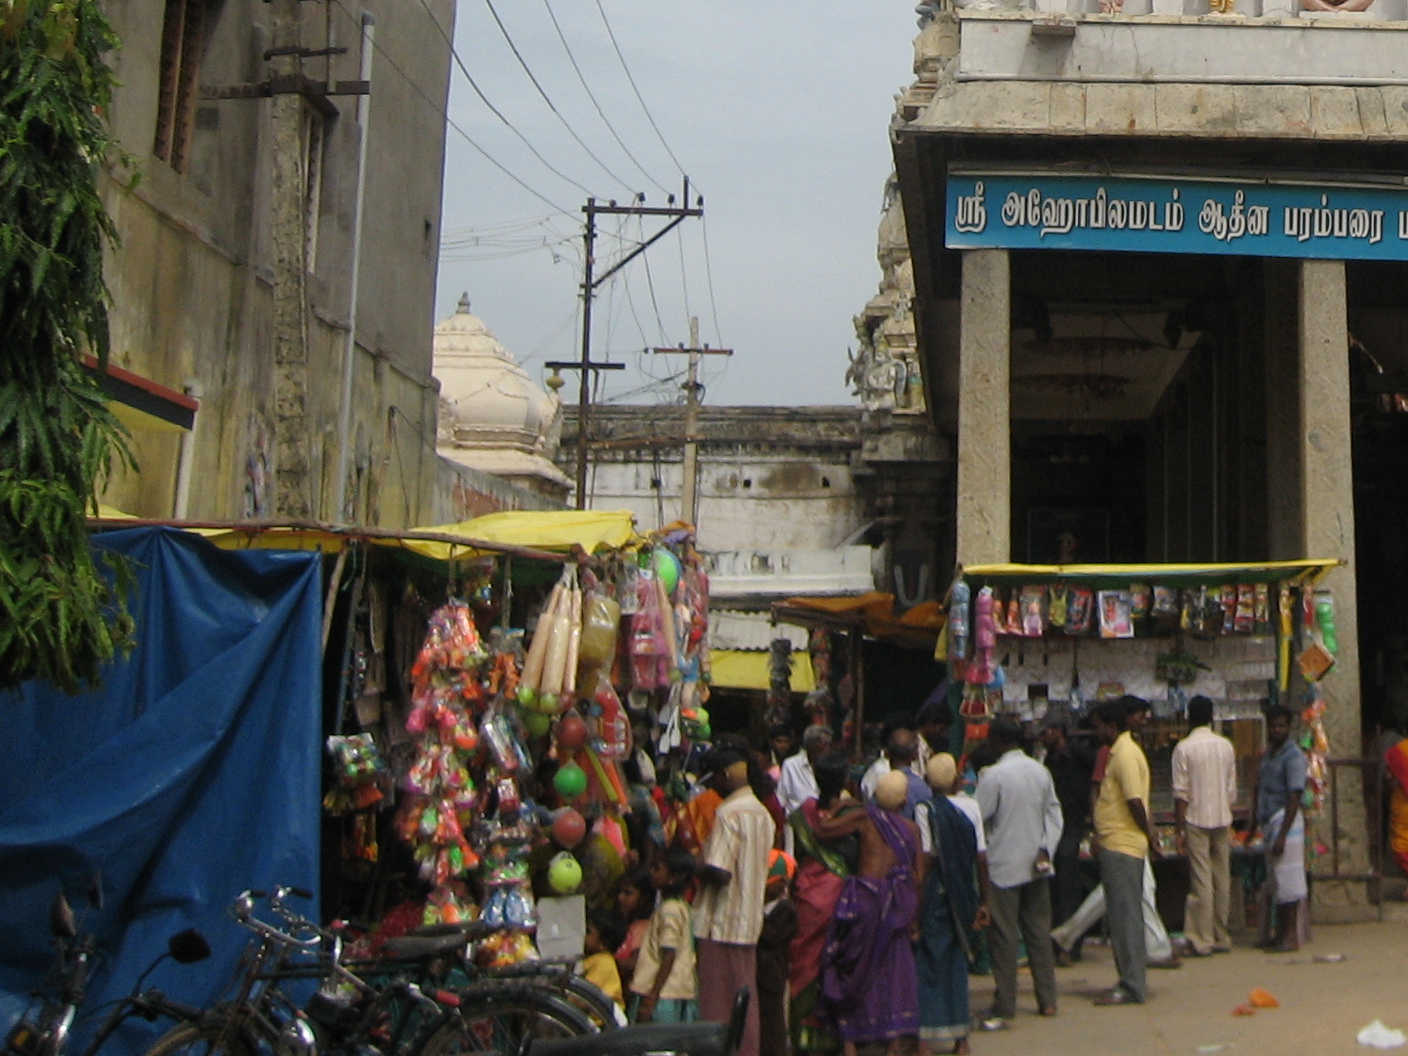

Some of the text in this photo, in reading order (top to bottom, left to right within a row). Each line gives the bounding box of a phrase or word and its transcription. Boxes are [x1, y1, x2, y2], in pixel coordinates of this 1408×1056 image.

[955, 181, 987, 234] ஸ்ரீ
[1001, 187, 1184, 239] அஹோபிலமடம்
[1198, 189, 1270, 242] ஆதீன
[1284, 194, 1384, 244] பரம்பரை
